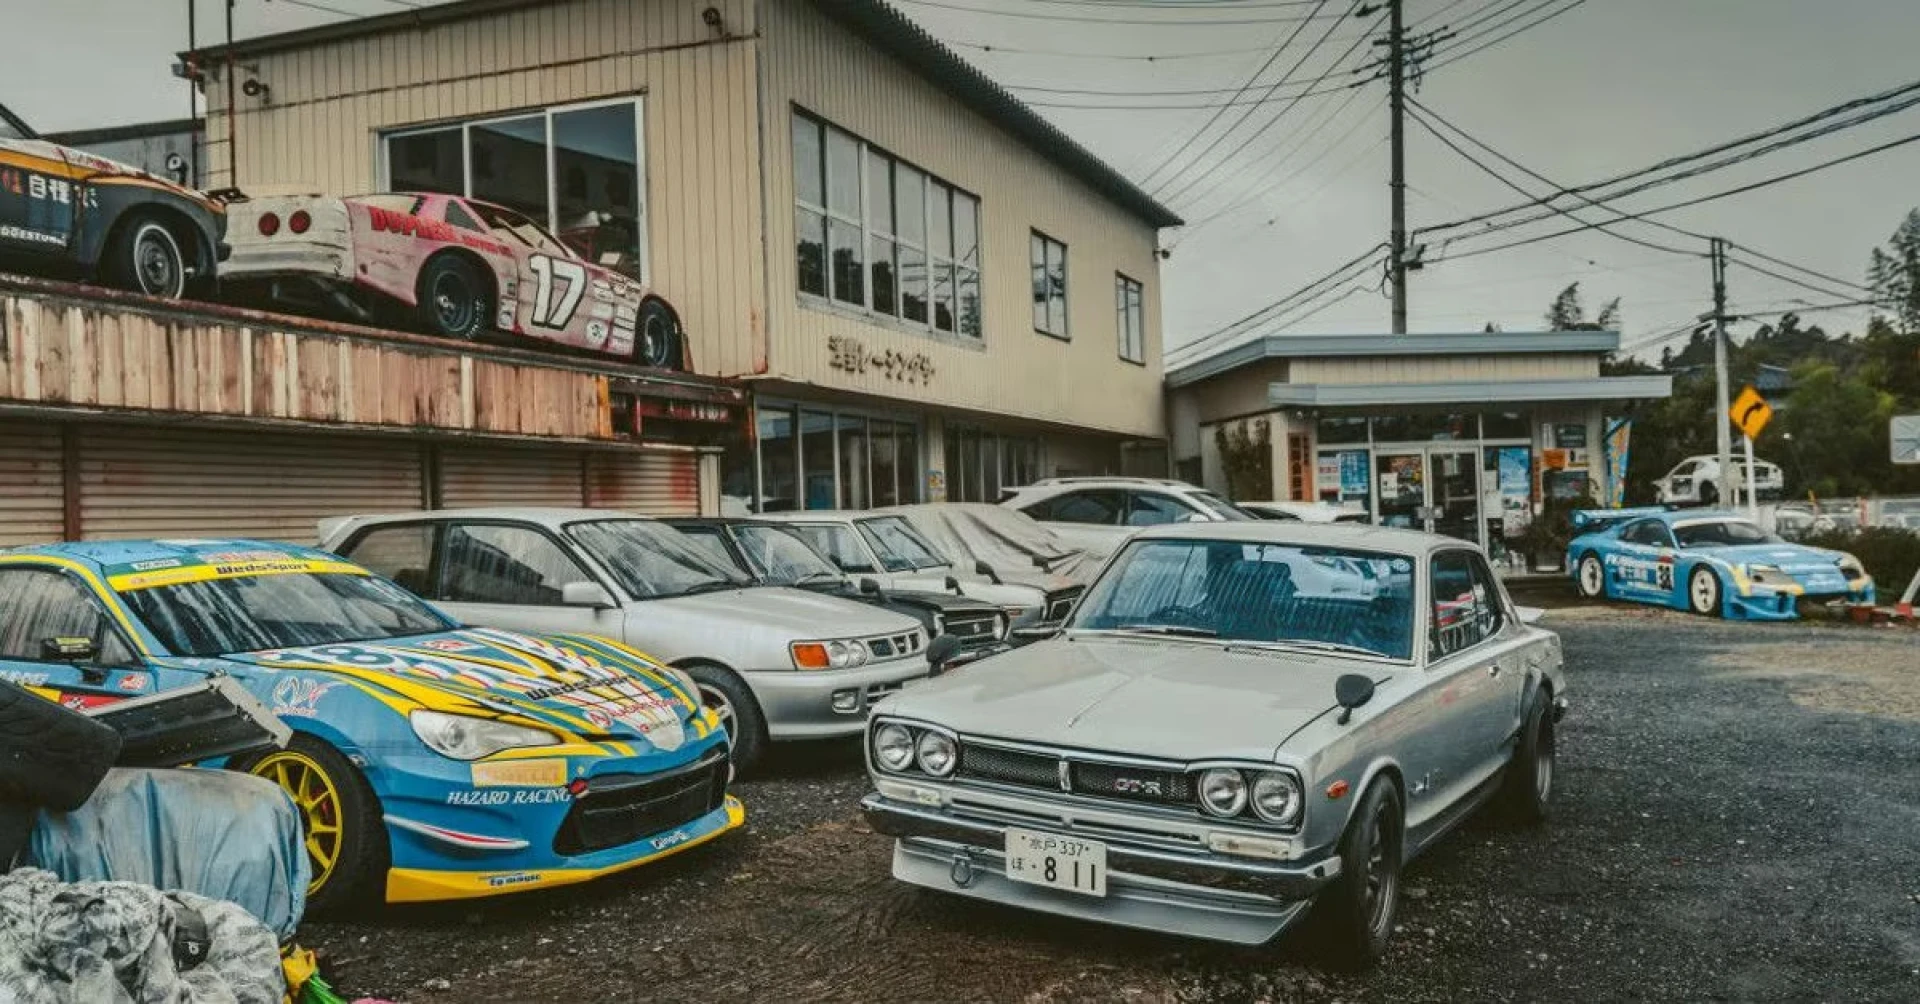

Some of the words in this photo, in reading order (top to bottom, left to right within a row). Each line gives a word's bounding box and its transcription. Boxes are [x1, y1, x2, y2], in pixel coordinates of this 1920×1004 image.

[529, 252, 587, 331] 17
[216, 561, 310, 575] WedsSport
[525, 676, 629, 701] WedsSport
[1113, 777, 1162, 795] GT-R
[446, 790, 509, 805] HAZARD
[512, 787, 572, 804] RACING
